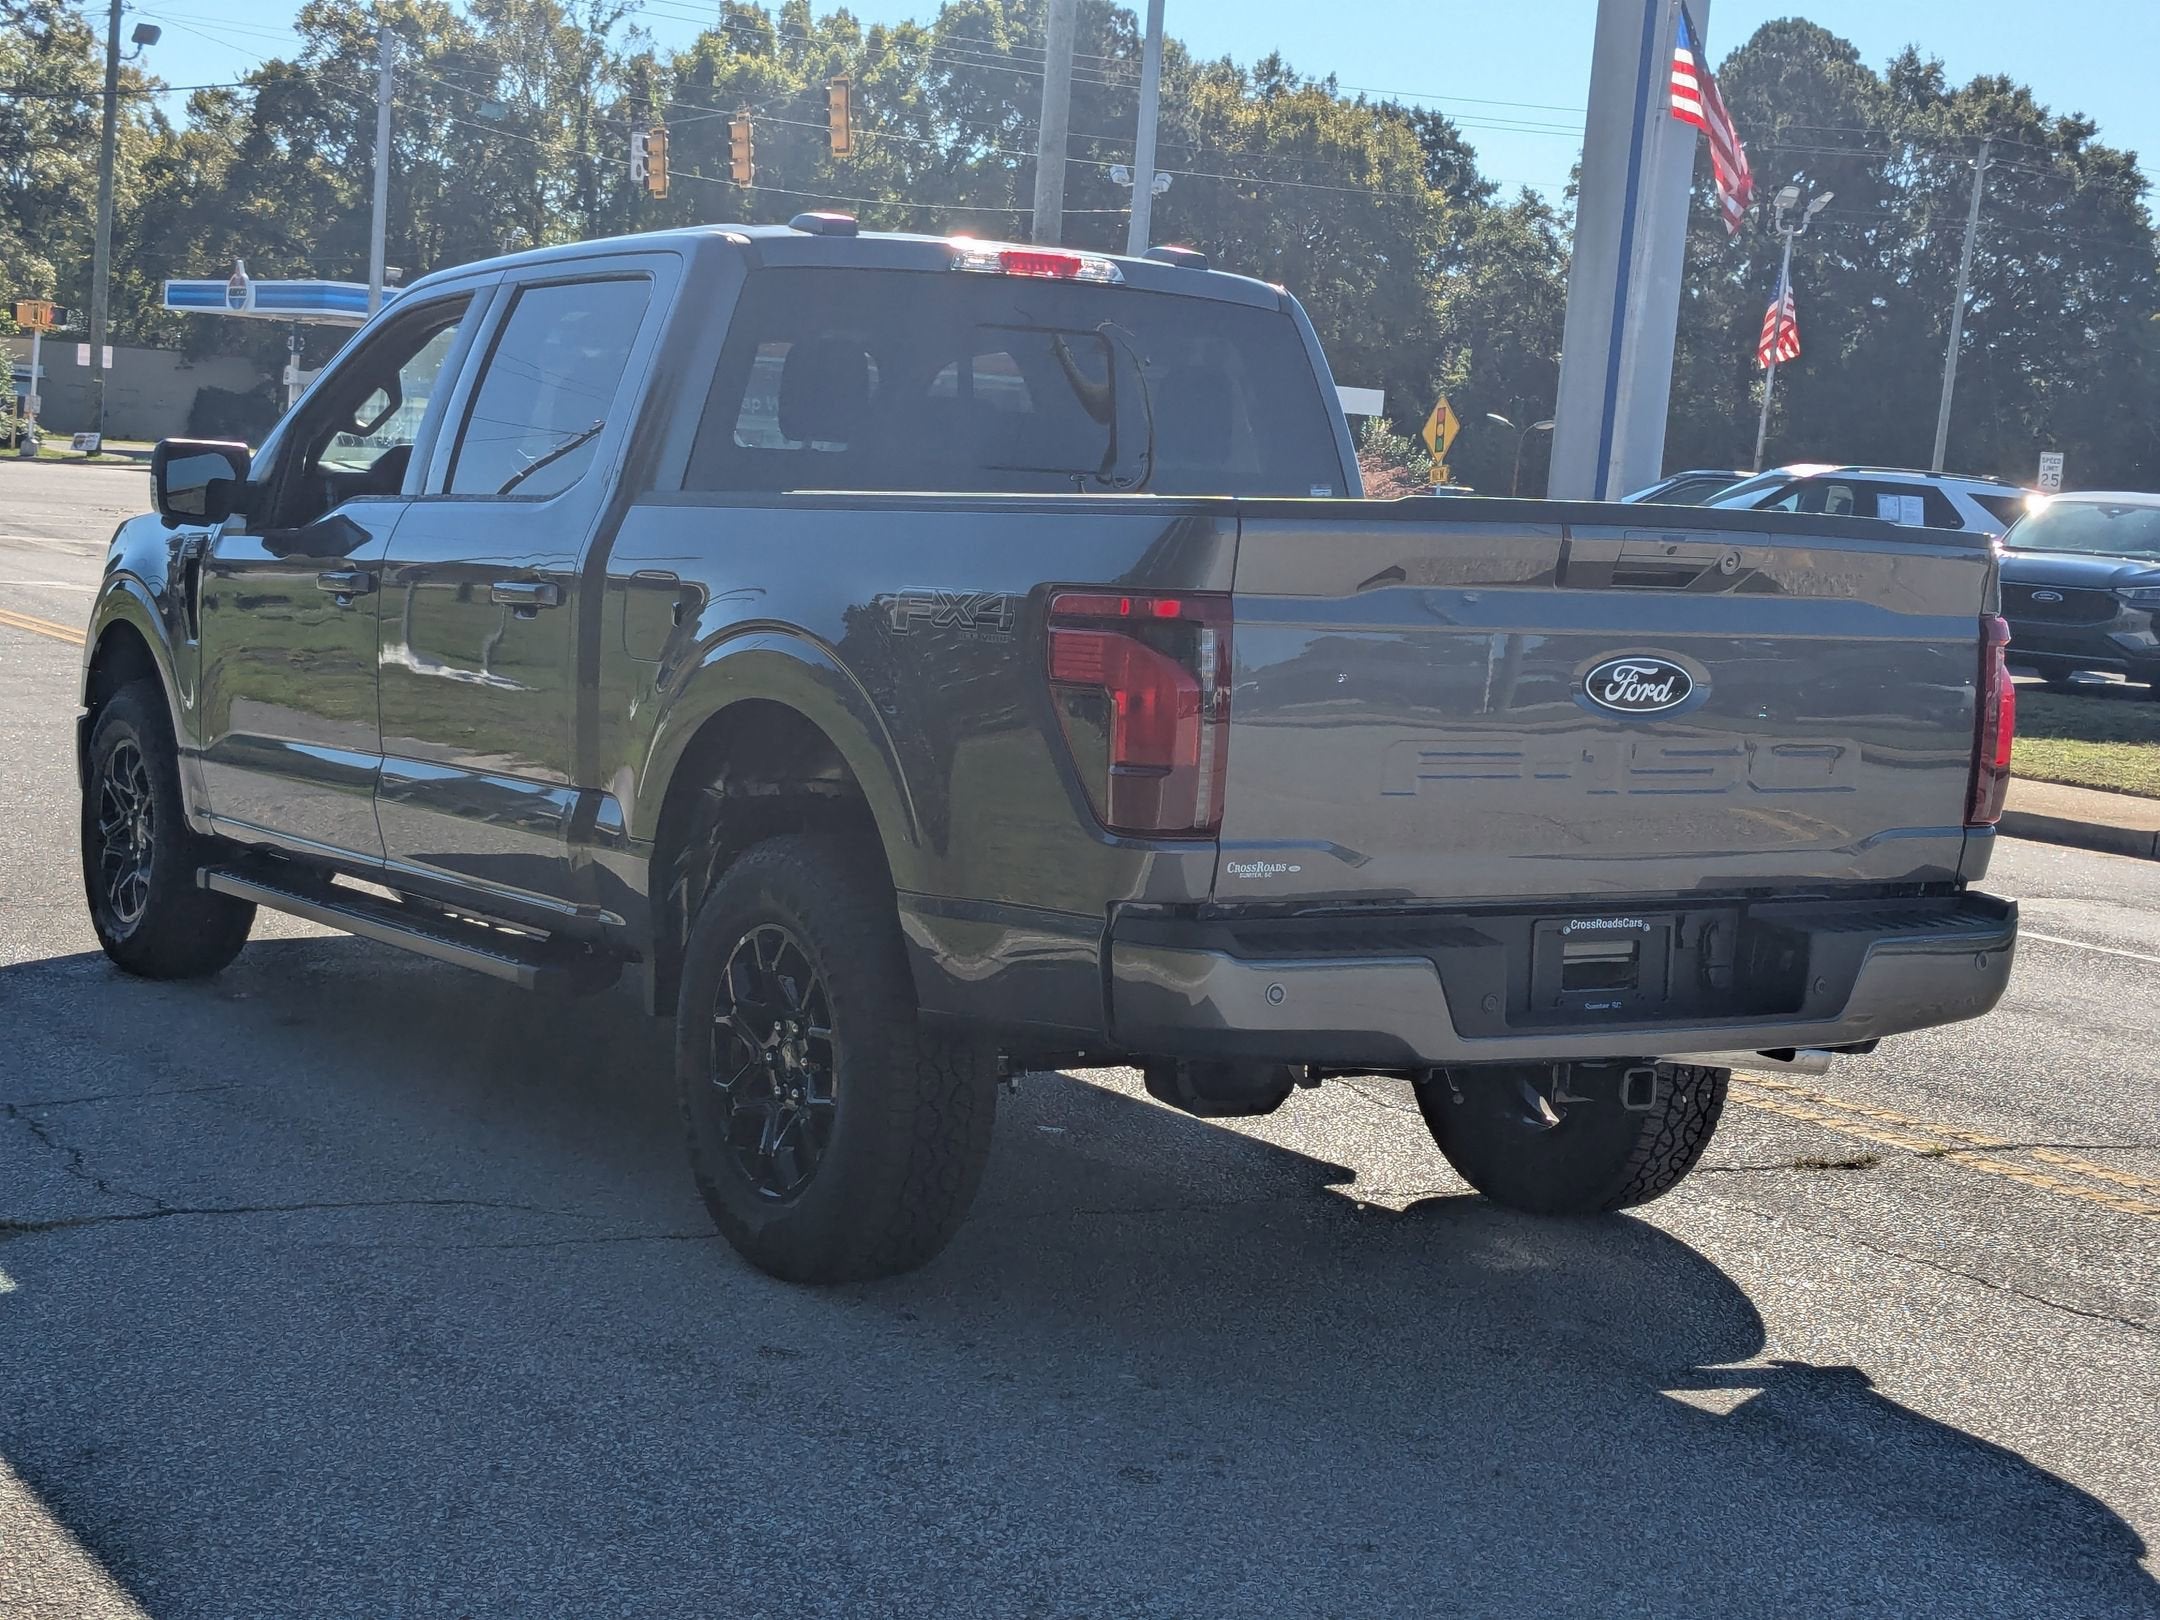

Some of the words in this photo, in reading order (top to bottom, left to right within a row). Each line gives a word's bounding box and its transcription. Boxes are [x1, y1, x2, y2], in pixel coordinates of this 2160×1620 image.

[2041, 473, 2060, 487] 25
[891, 585, 1016, 636] FX4
[1605, 665, 1675, 702] Ford
[1570, 918, 1643, 930] CrossRoadsCars
